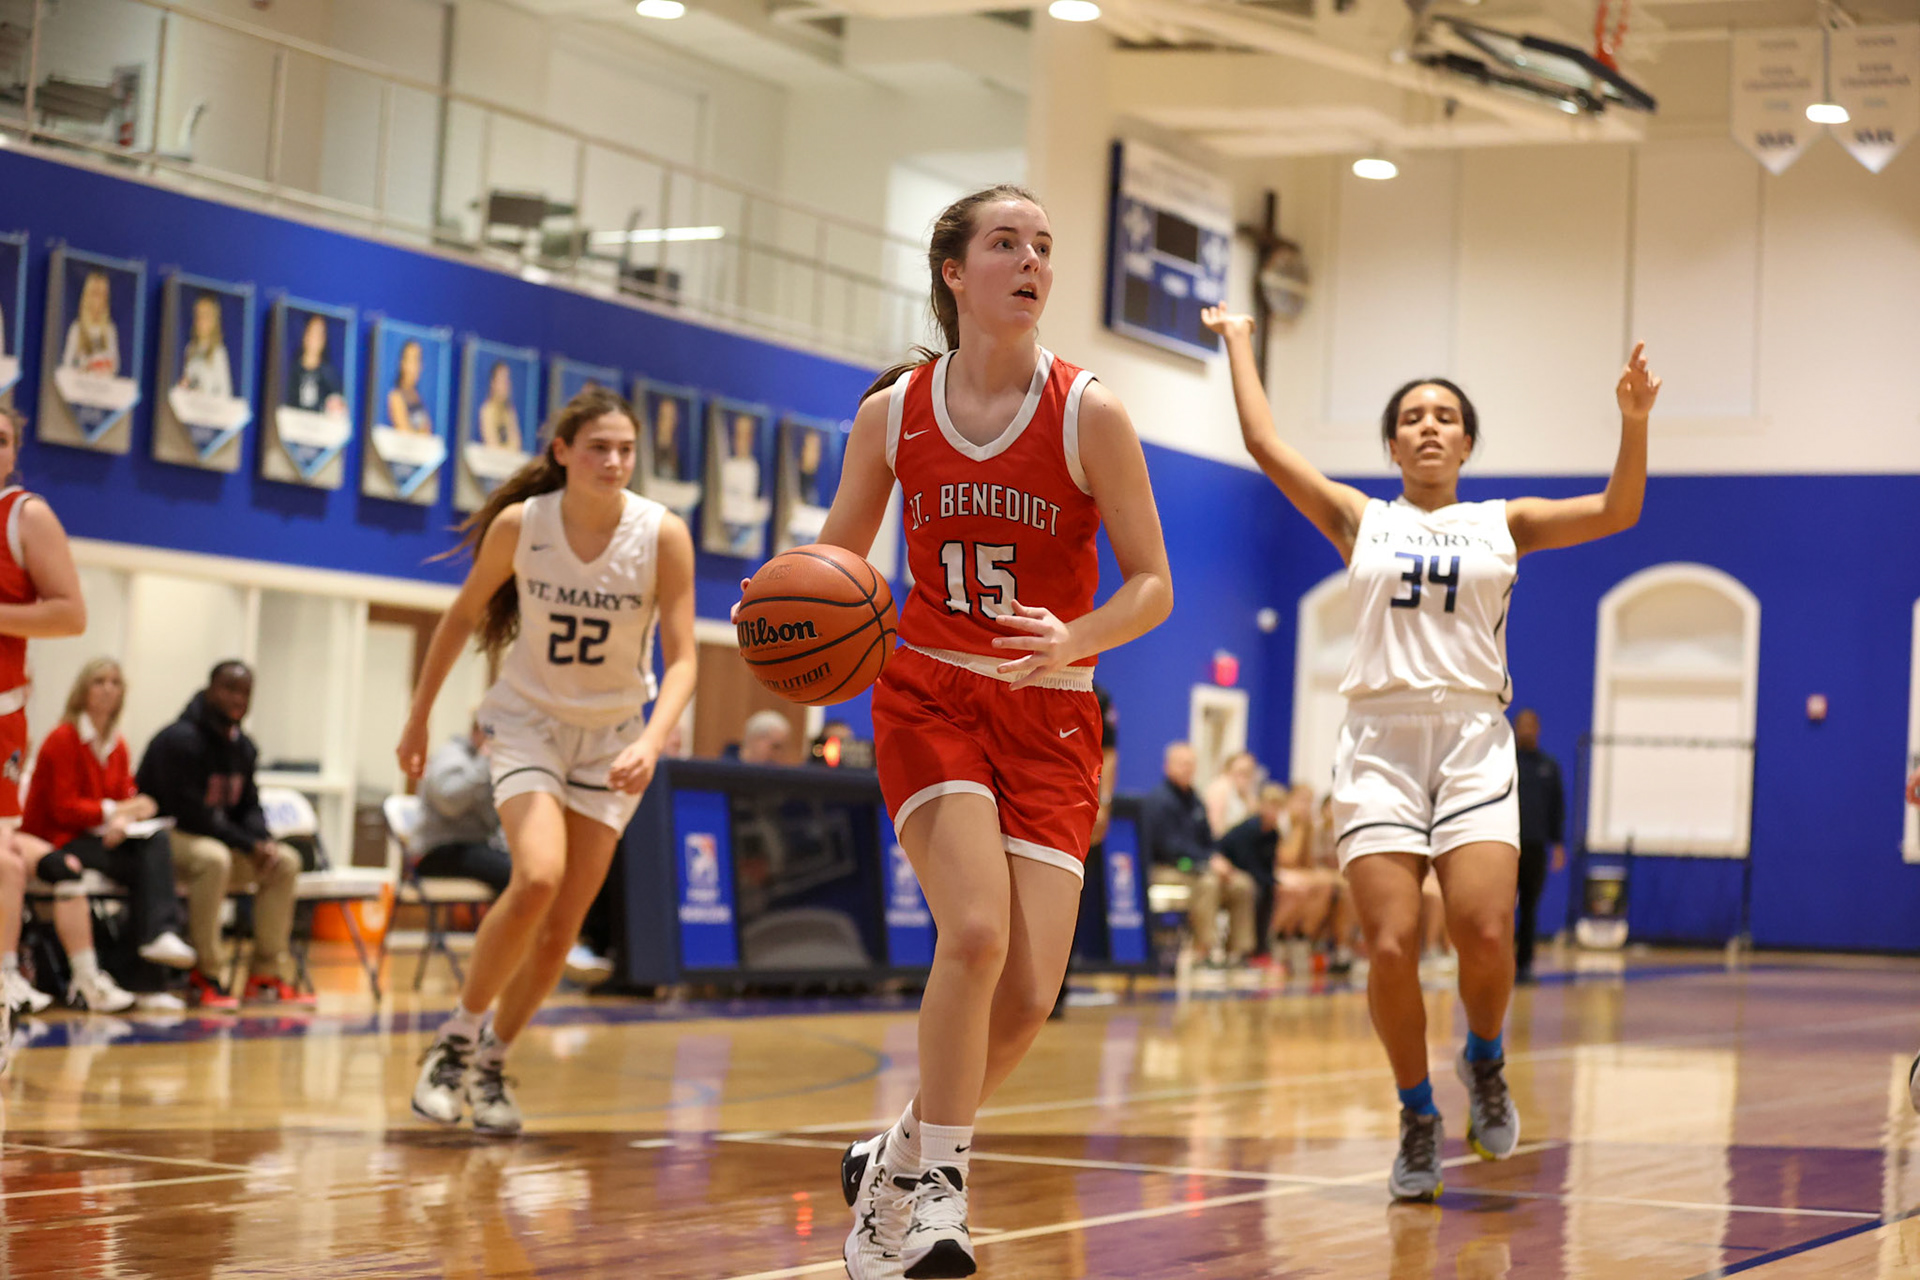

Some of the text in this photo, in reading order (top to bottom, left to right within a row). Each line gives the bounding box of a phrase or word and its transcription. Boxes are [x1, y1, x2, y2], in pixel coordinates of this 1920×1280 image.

[939, 482, 1062, 537] BENEDICT
[554, 586, 644, 612] MARY'S
[939, 540, 1018, 621] 15
[1390, 551, 1461, 614] 34
[548, 612, 611, 666] 22
[736, 616, 818, 649] Wilson
